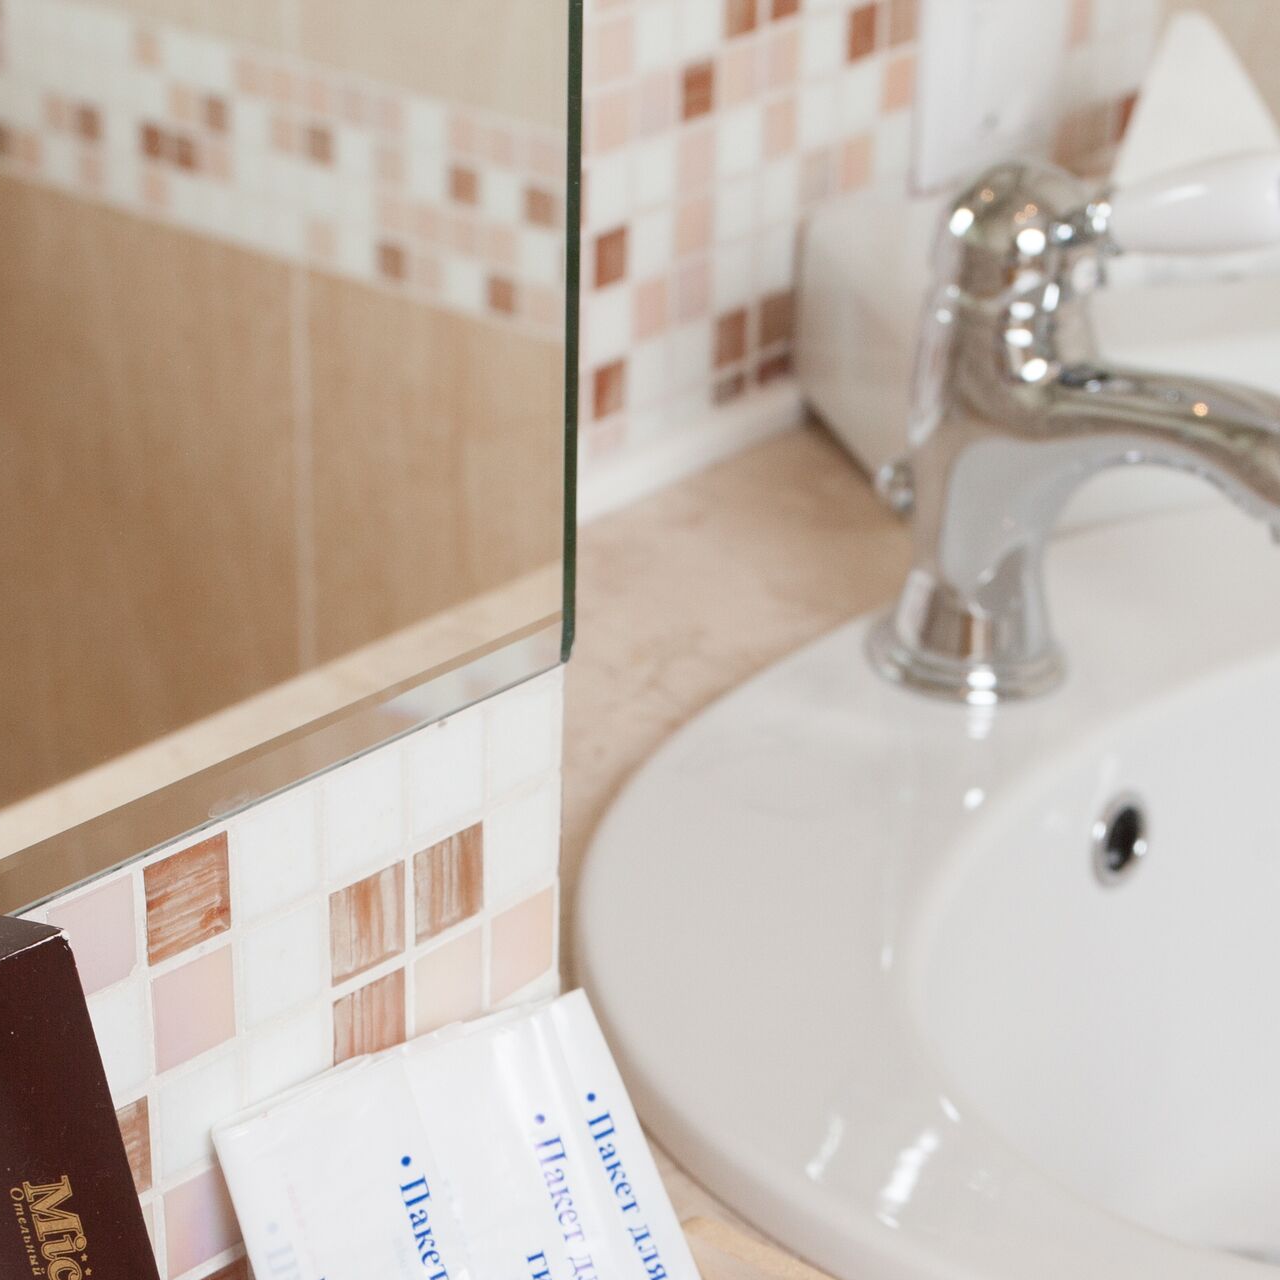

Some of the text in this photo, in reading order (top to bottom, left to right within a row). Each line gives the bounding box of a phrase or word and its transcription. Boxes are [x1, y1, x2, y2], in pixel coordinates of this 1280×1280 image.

[535, 1135, 585, 1243] Пакет
[587, 1110, 641, 1215] Пакет
[10, 1187, 40, 1277] Отельный
